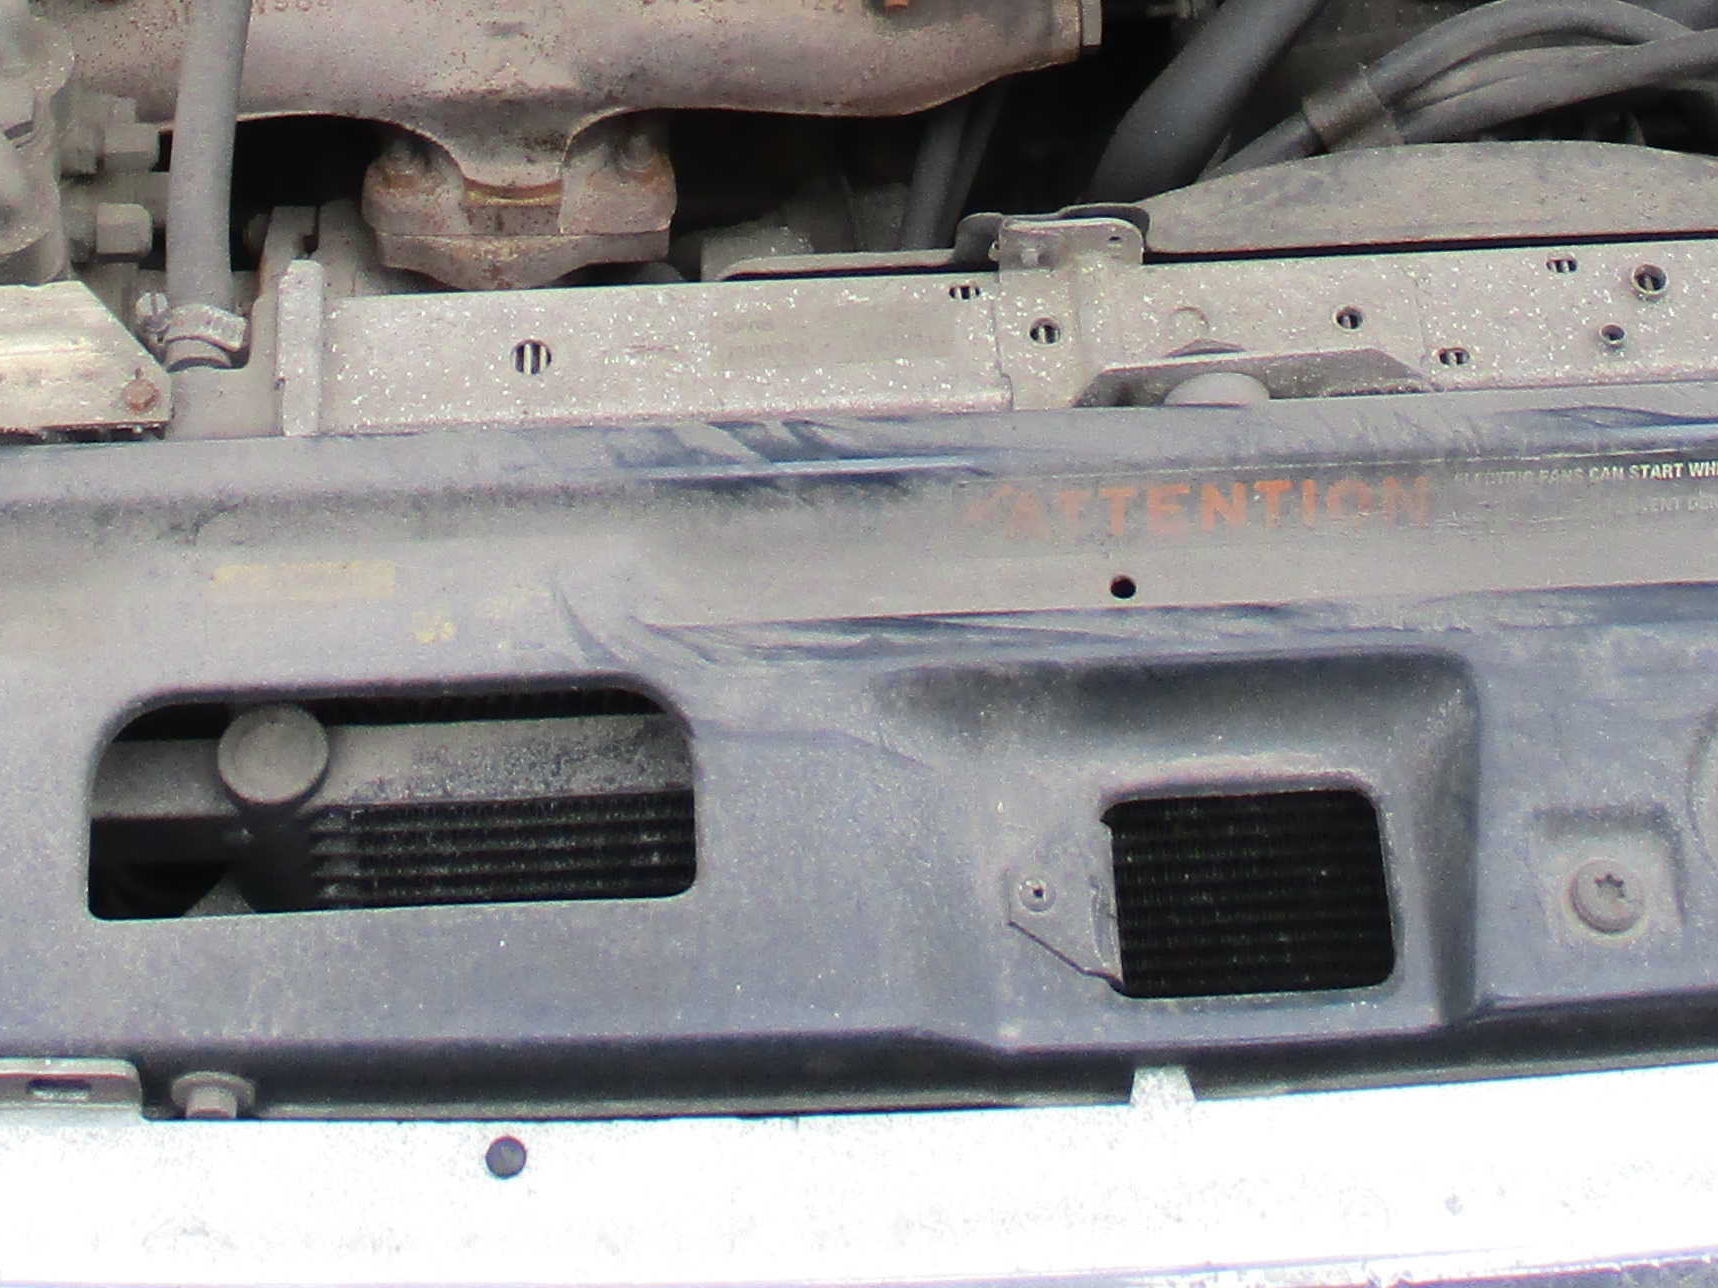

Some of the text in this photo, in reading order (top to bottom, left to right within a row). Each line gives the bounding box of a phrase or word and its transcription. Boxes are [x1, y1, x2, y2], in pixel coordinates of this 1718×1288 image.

[1538, 467, 1584, 485] FANS
[1588, 465, 1624, 483] CAN
[1628, 461, 1684, 481] START
[1001, 474, 1430, 542] ATTENTION
